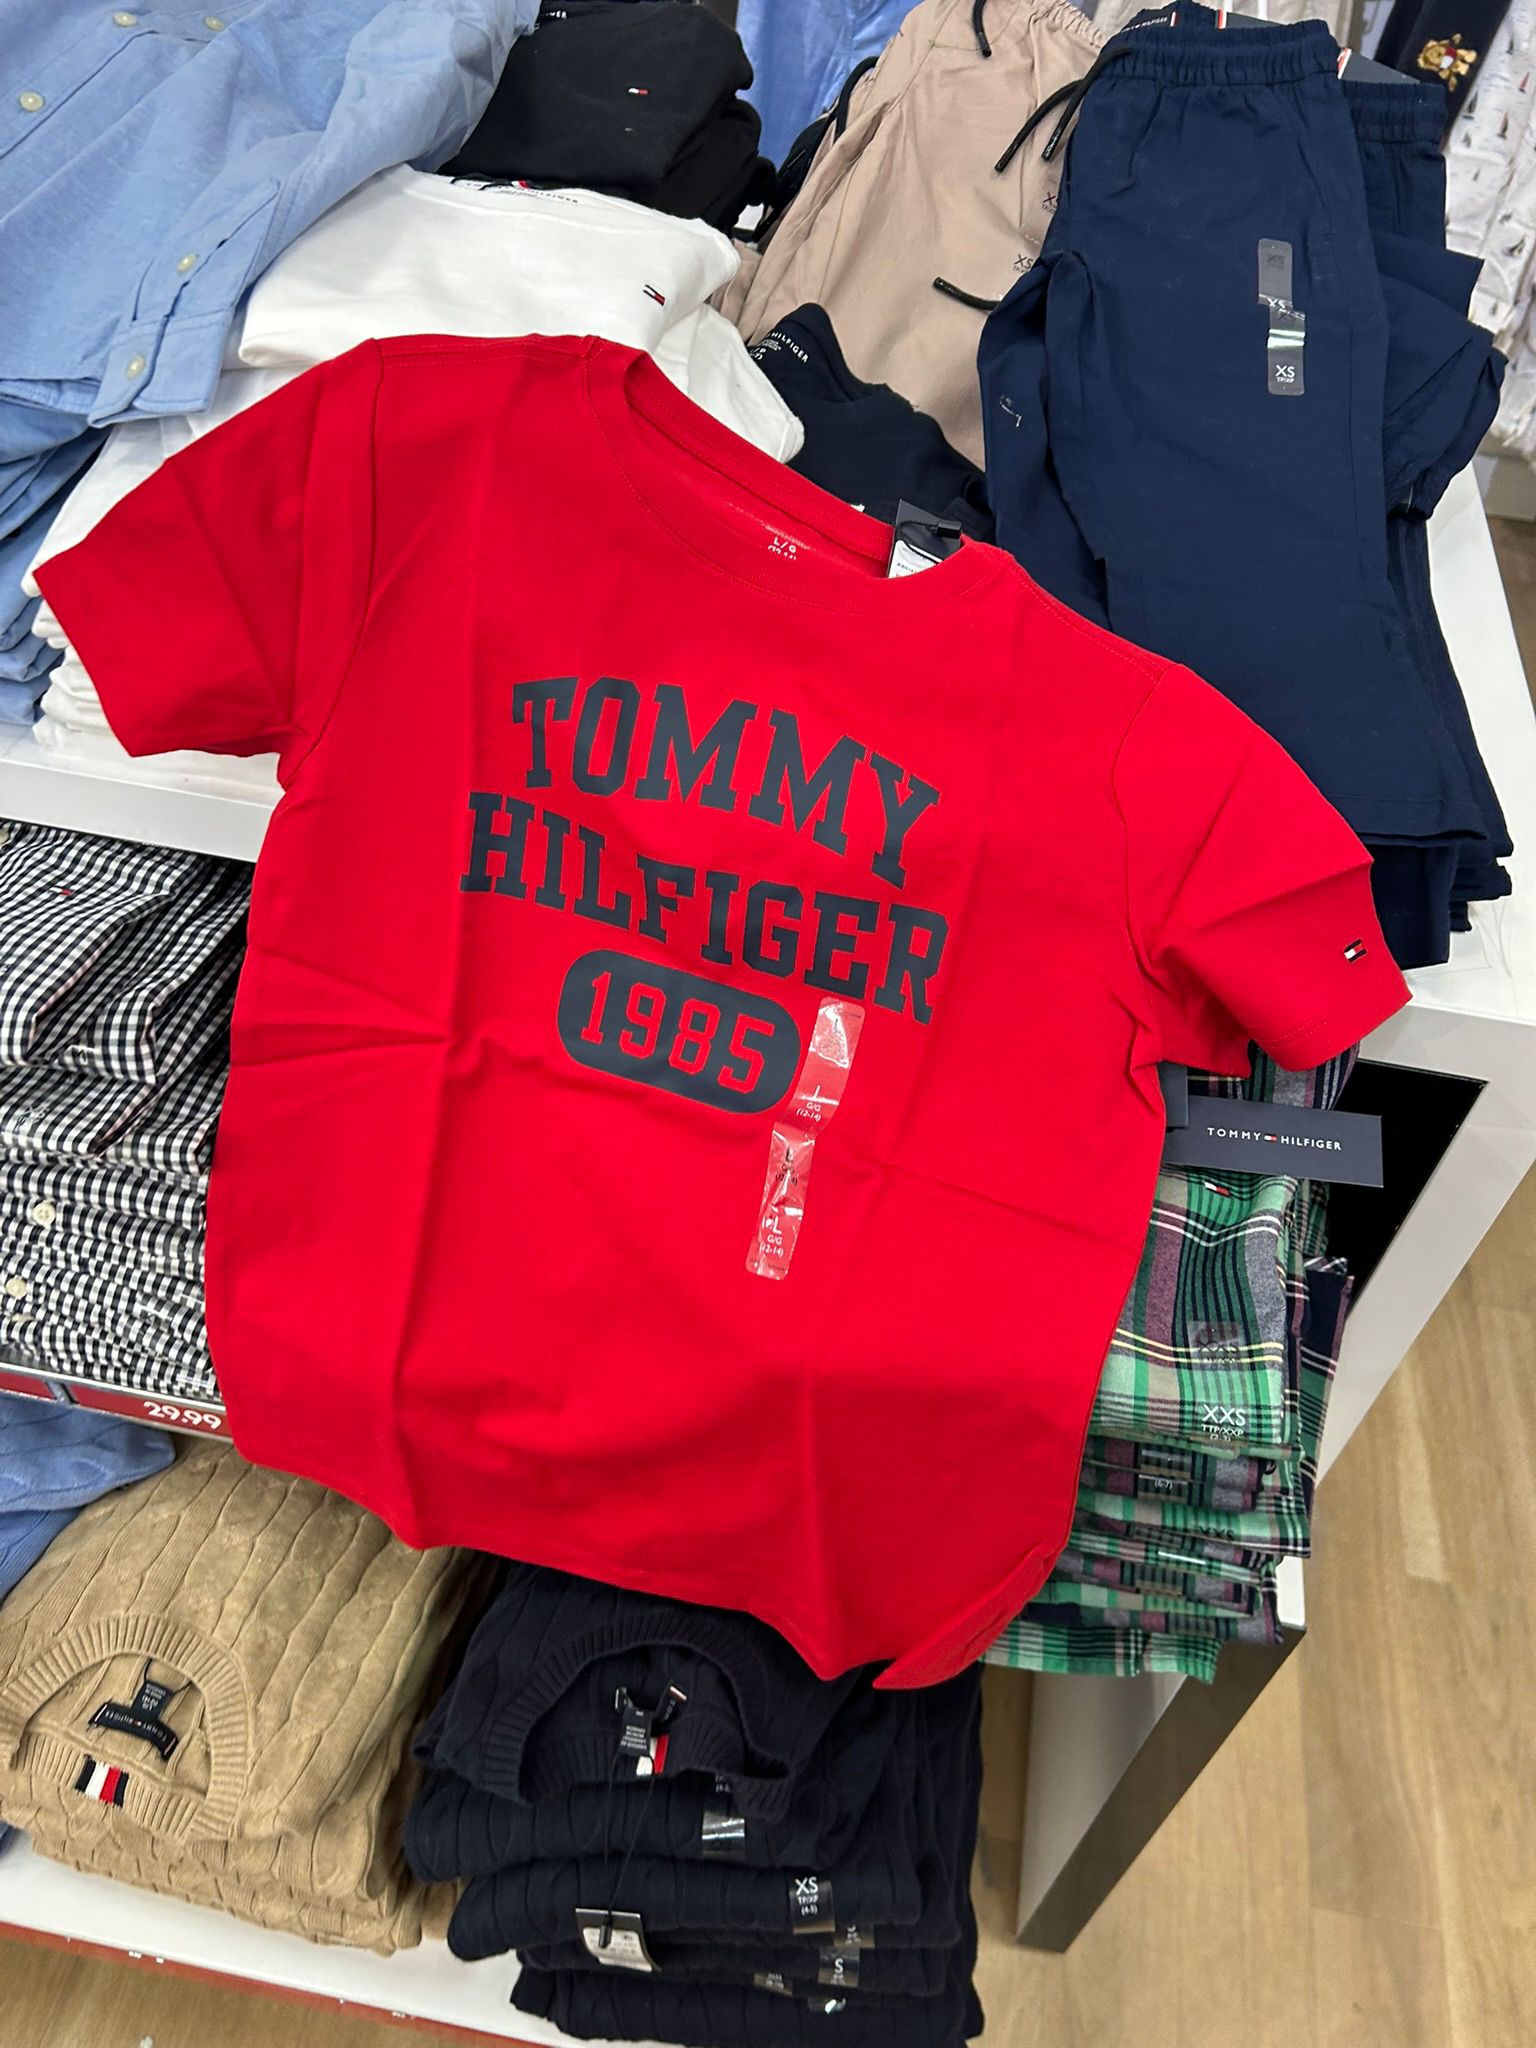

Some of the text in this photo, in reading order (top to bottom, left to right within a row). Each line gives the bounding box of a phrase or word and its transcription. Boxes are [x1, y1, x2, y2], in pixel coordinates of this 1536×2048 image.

[1014, 254, 1034, 270] XS
[771, 332, 809, 363] HILFIGER
[1275, 364, 1296, 378] XS
[773, 536, 797, 554] L/G
[512, 676, 941, 889] TOMMY
[460, 791, 950, 1025] HILFIGER
[580, 971, 777, 1094] 1985
[796, 1108, 822, 1122] (12-14)
[806, 1102, 822, 1113] G/G
[1207, 1127, 1342, 1151] TOMMY HILFIGER
[767, 1234, 783, 1246] G/G
[759, 1243, 785, 1257] (12-14)
[143, 1401, 222, 1430] 29.99
[1202, 1404, 1247, 1427] XXS
[1201, 1424, 1244, 1437] TTP/XXP
[794, 1876, 819, 1896] XS
[833, 1958, 844, 1974] S
